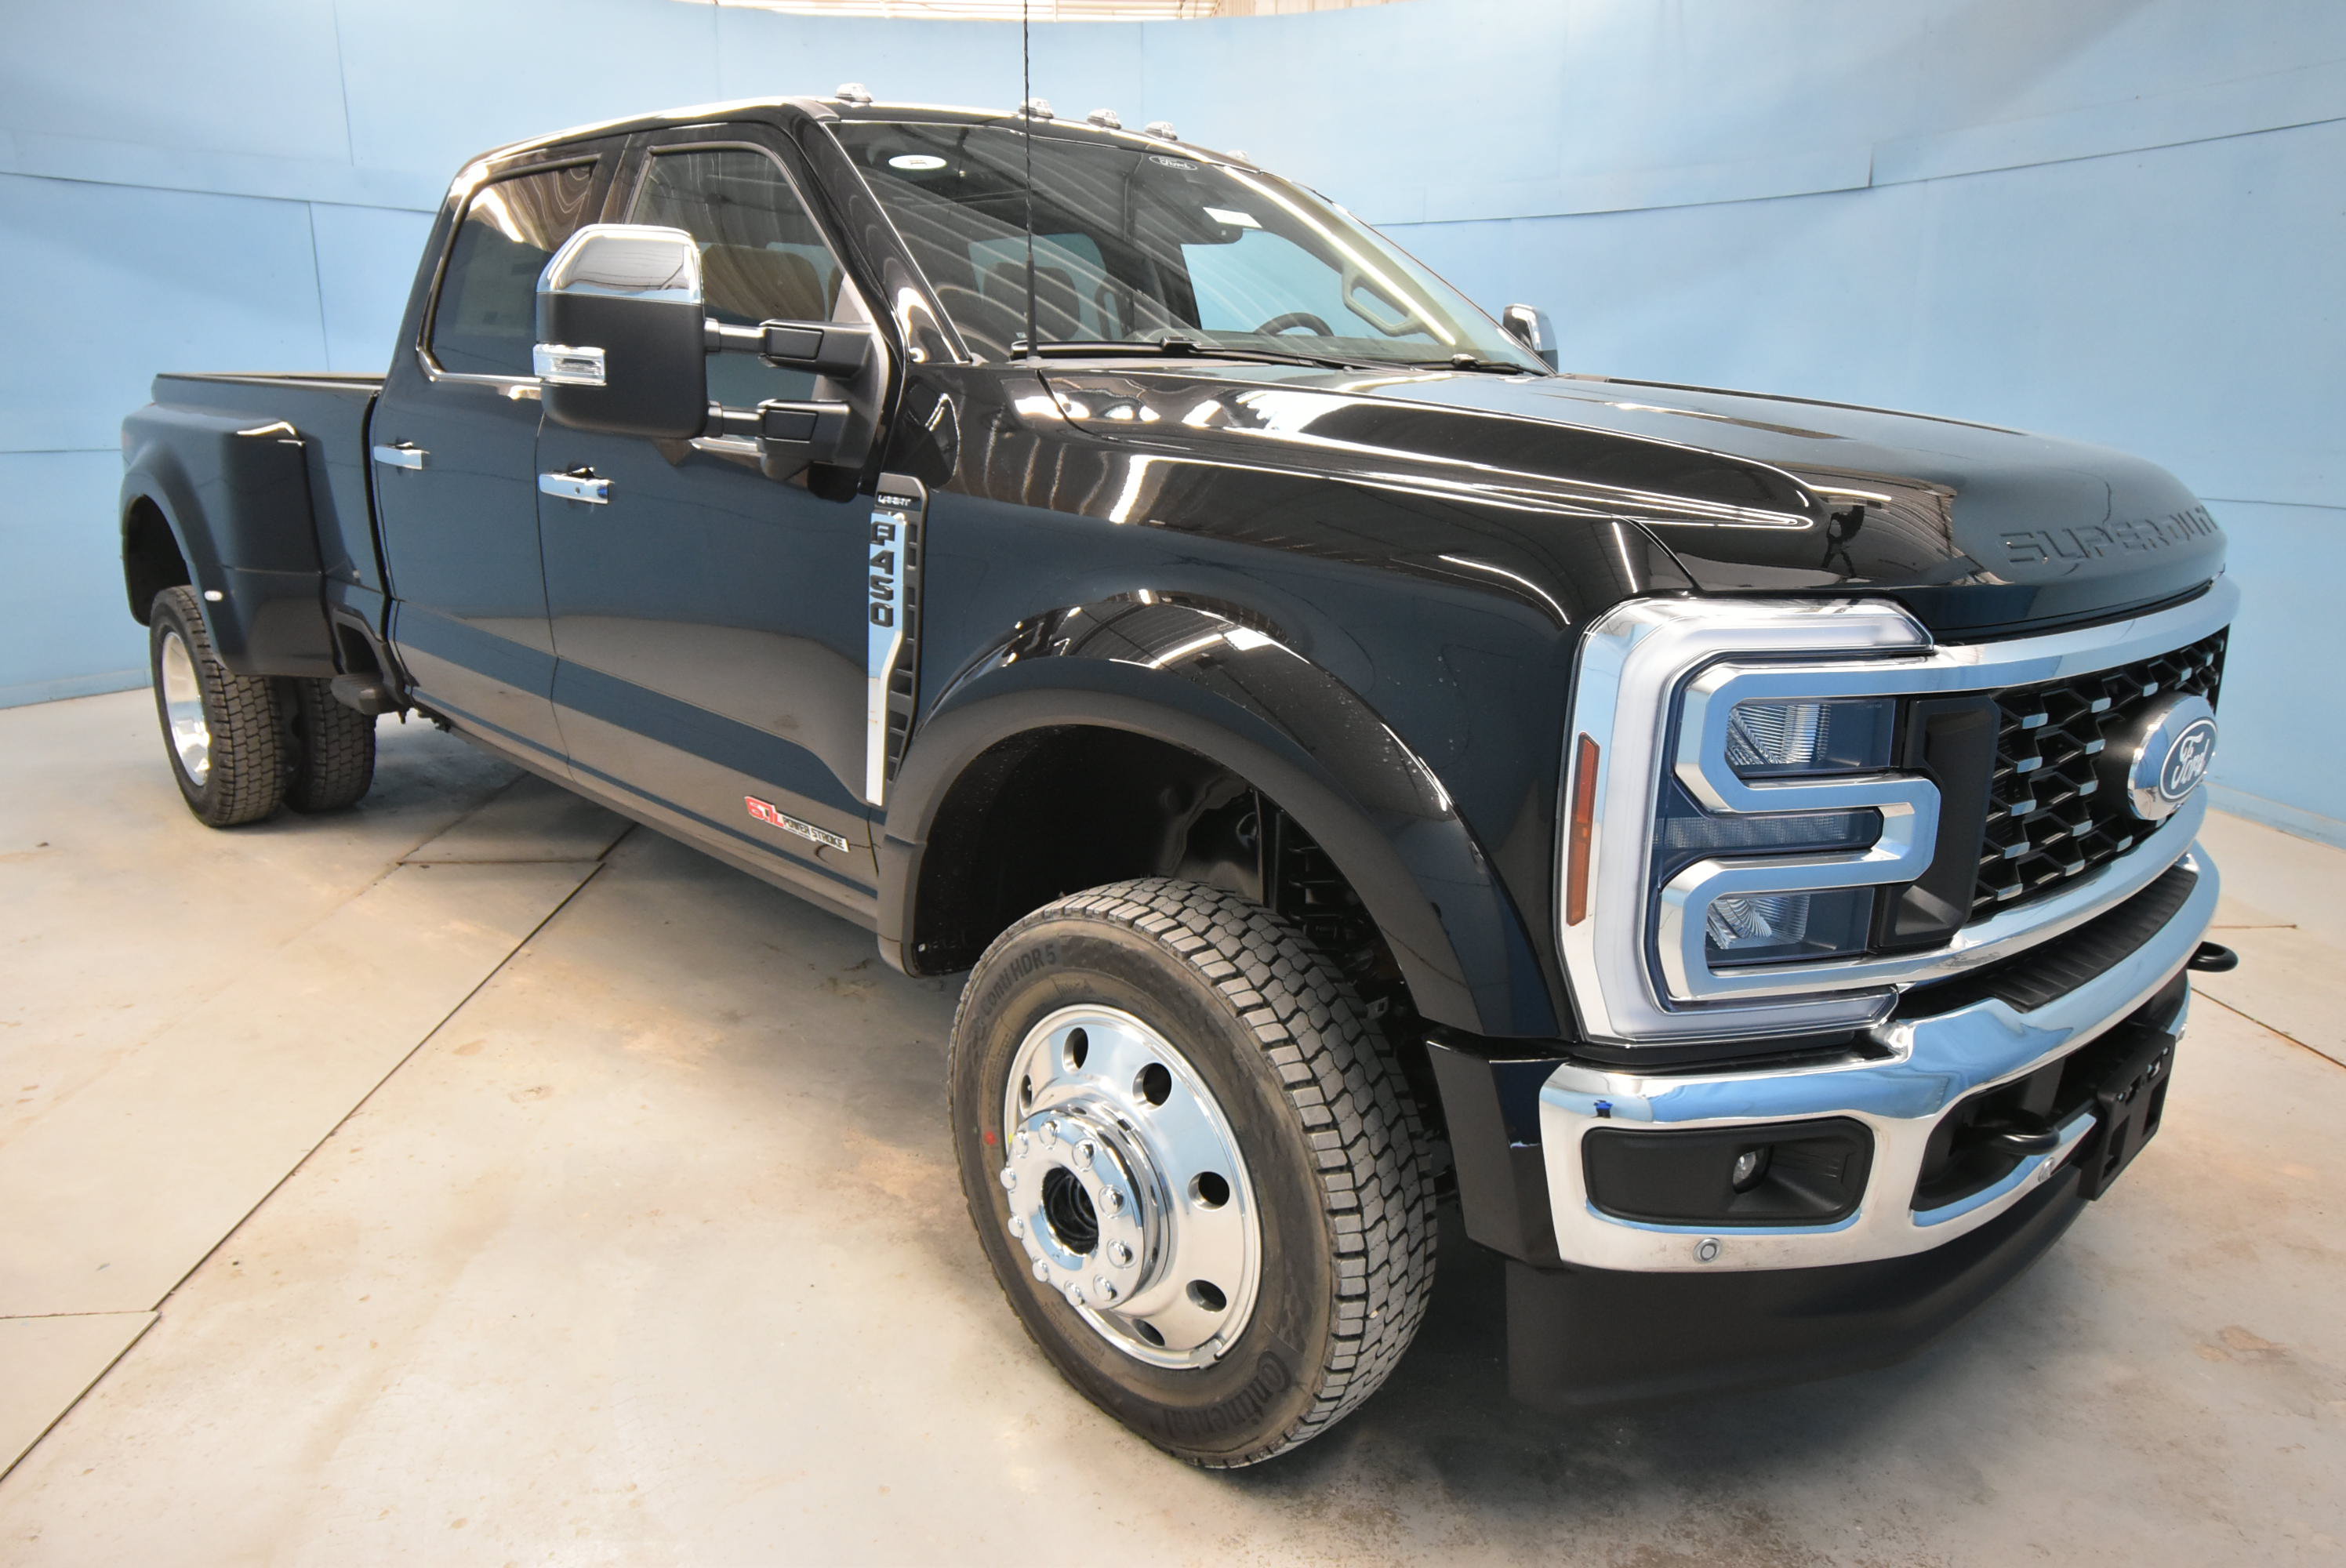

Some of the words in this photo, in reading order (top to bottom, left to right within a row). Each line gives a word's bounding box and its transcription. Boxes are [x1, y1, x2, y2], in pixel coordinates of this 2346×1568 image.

[1158, 157, 1190, 169] Ford
[2170, 731, 2210, 790] Ford
[1009, 946, 1044, 982] HDR
